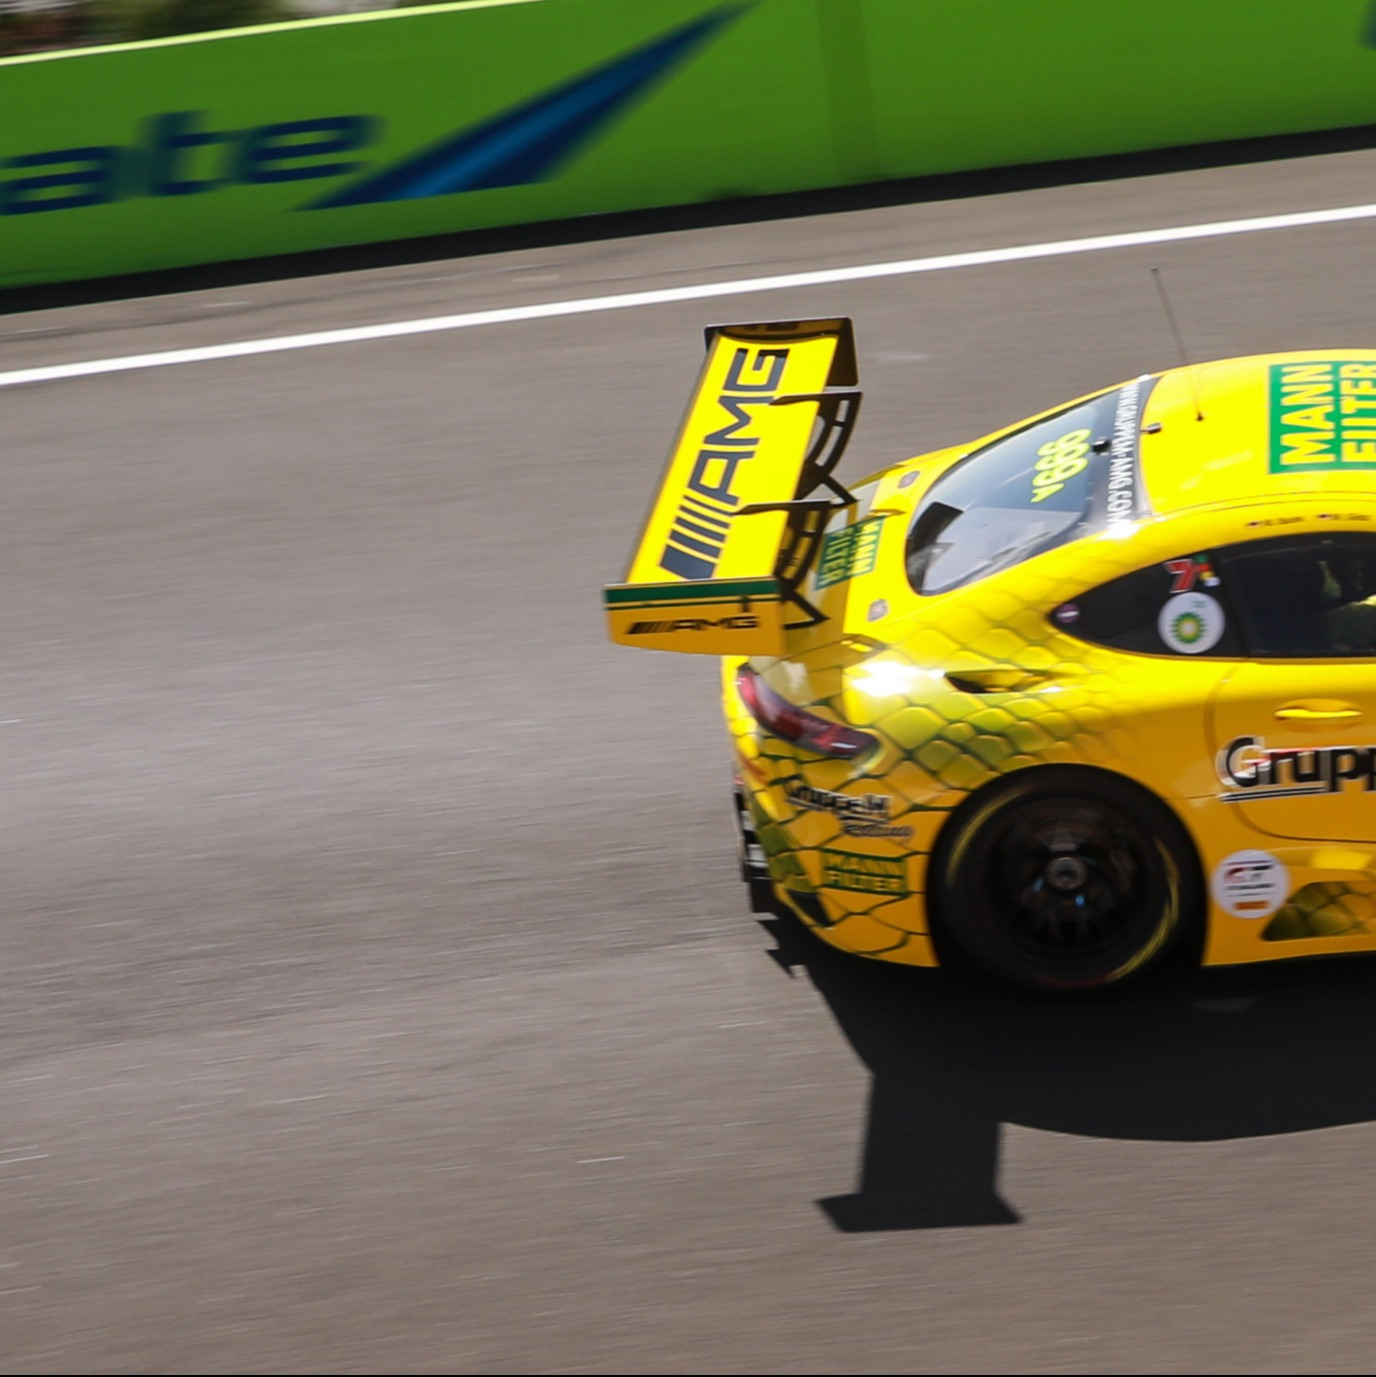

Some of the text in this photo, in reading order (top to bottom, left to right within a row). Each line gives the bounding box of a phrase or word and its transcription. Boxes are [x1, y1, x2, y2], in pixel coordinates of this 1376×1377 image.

[687, 347, 790, 507] AMG
[1279, 363, 1336, 465] MANN
[1030, 428, 1092, 504] 999A
